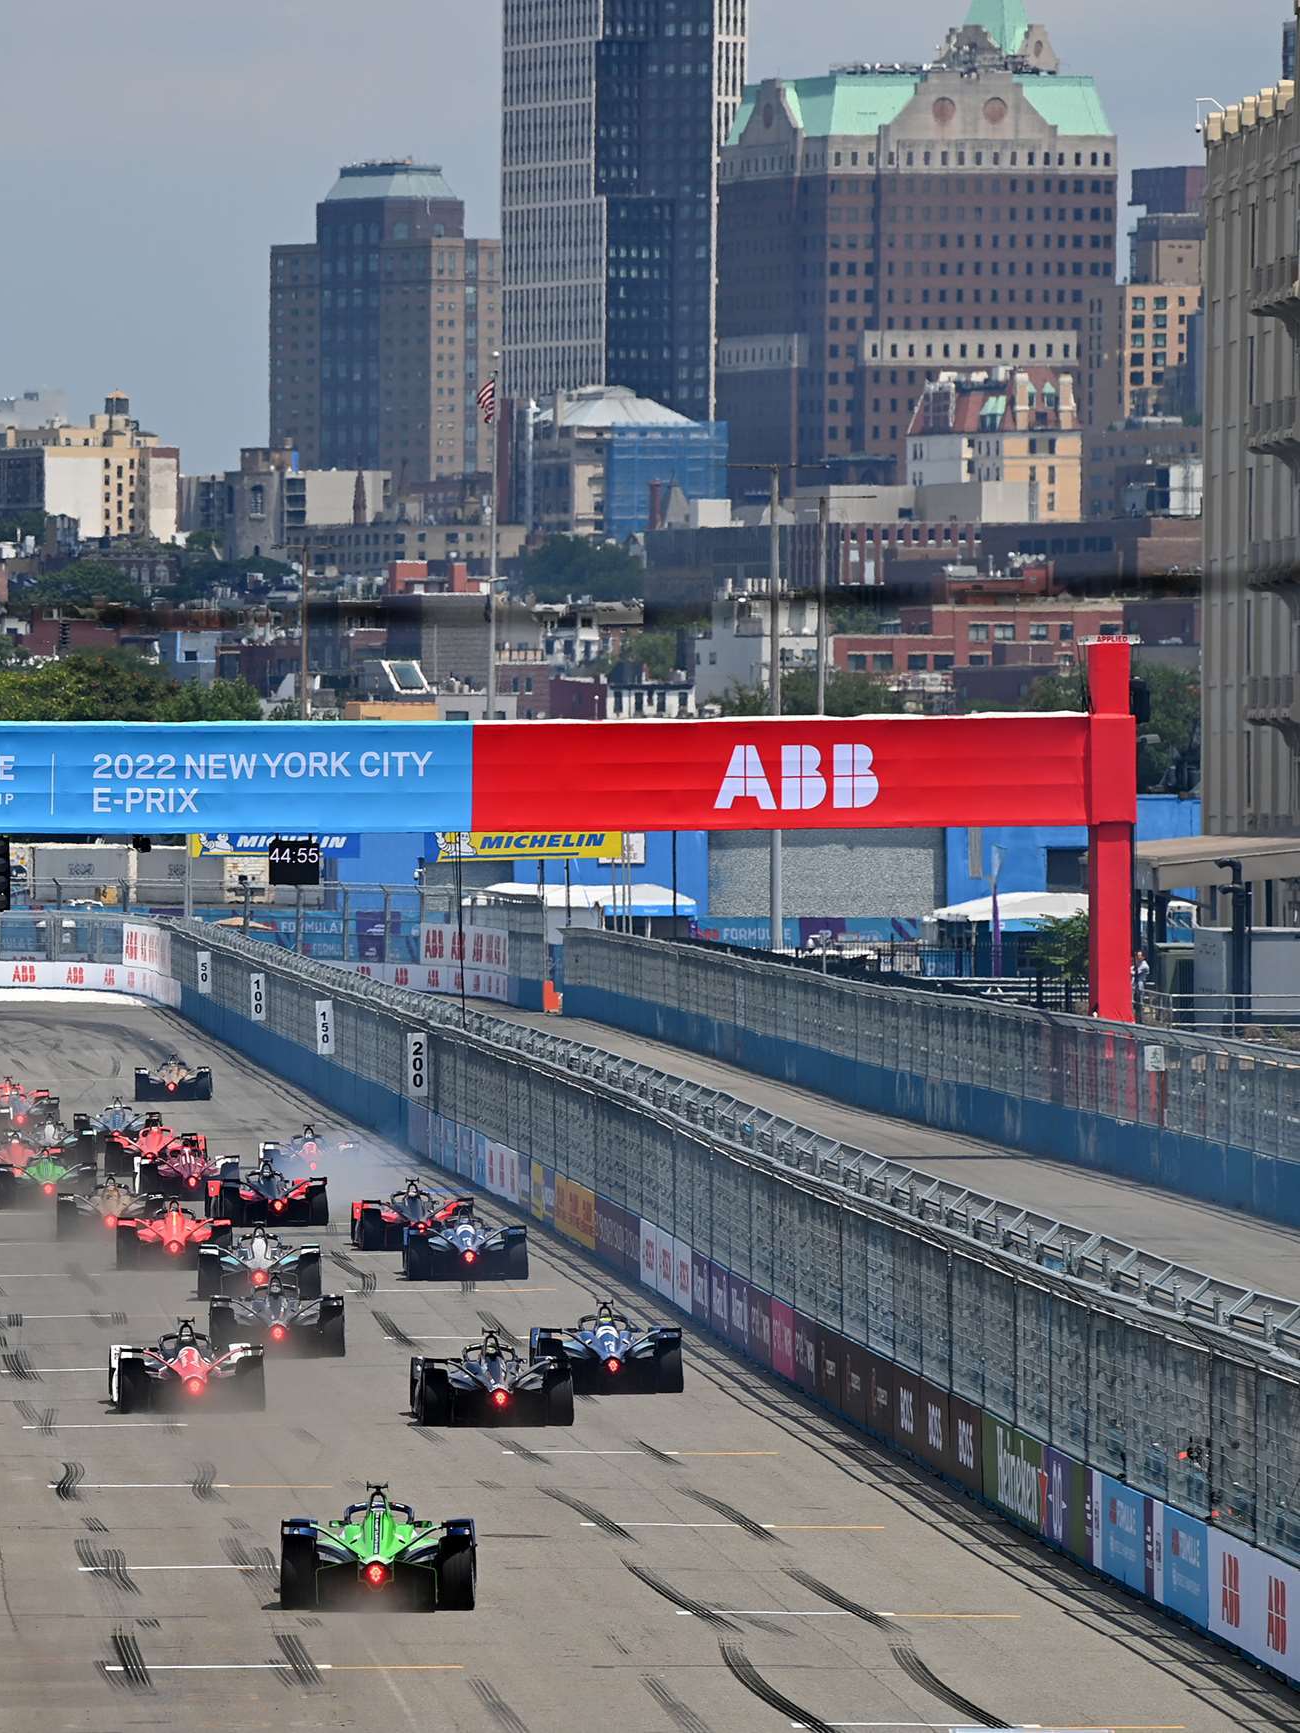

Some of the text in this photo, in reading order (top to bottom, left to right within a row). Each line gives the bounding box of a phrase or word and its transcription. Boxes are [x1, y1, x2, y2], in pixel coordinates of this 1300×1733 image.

[92, 751, 433, 780] 2022 NEW YORK CITY
[716, 745, 879, 809] ABB
[93, 787, 199, 813] E-PRIX
[270, 847, 319, 864] 44:55
[479, 833, 606, 850] MICHELIN
[424, 929, 445, 960] ABB
[13, 965, 37, 983] ABB
[66, 966, 85, 984] ABB
[200, 962, 208, 983] 50
[254, 979, 264, 1014] 100
[320, 1011, 330, 1043] 150
[412, 1041, 424, 1088] 200
[996, 1426, 1038, 1525] Heineken
[1222, 1551, 1240, 1629] ABB
[1267, 1575, 1287, 1656] ABB
